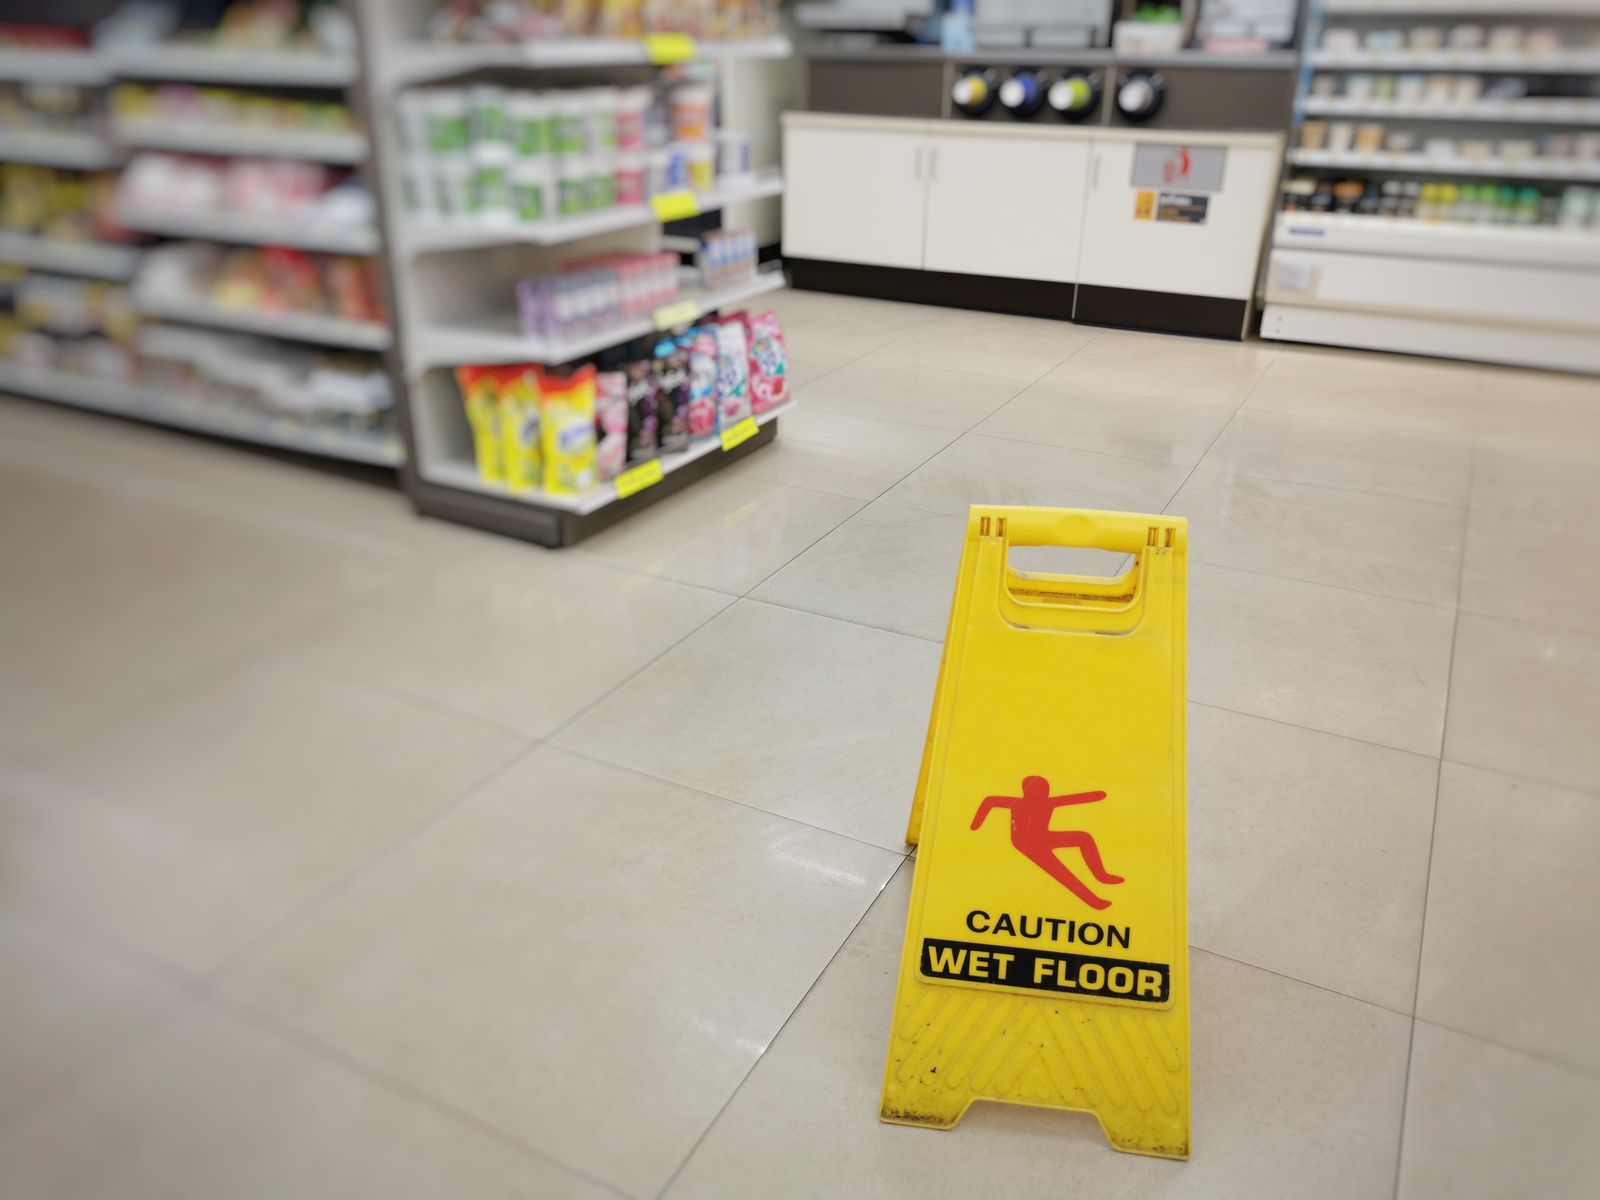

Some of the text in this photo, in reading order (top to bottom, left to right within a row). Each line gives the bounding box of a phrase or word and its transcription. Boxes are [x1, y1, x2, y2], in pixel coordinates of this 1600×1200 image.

[966, 910, 1131, 949] CAUTION
[928, 945, 1163, 998] WET FLOOR
